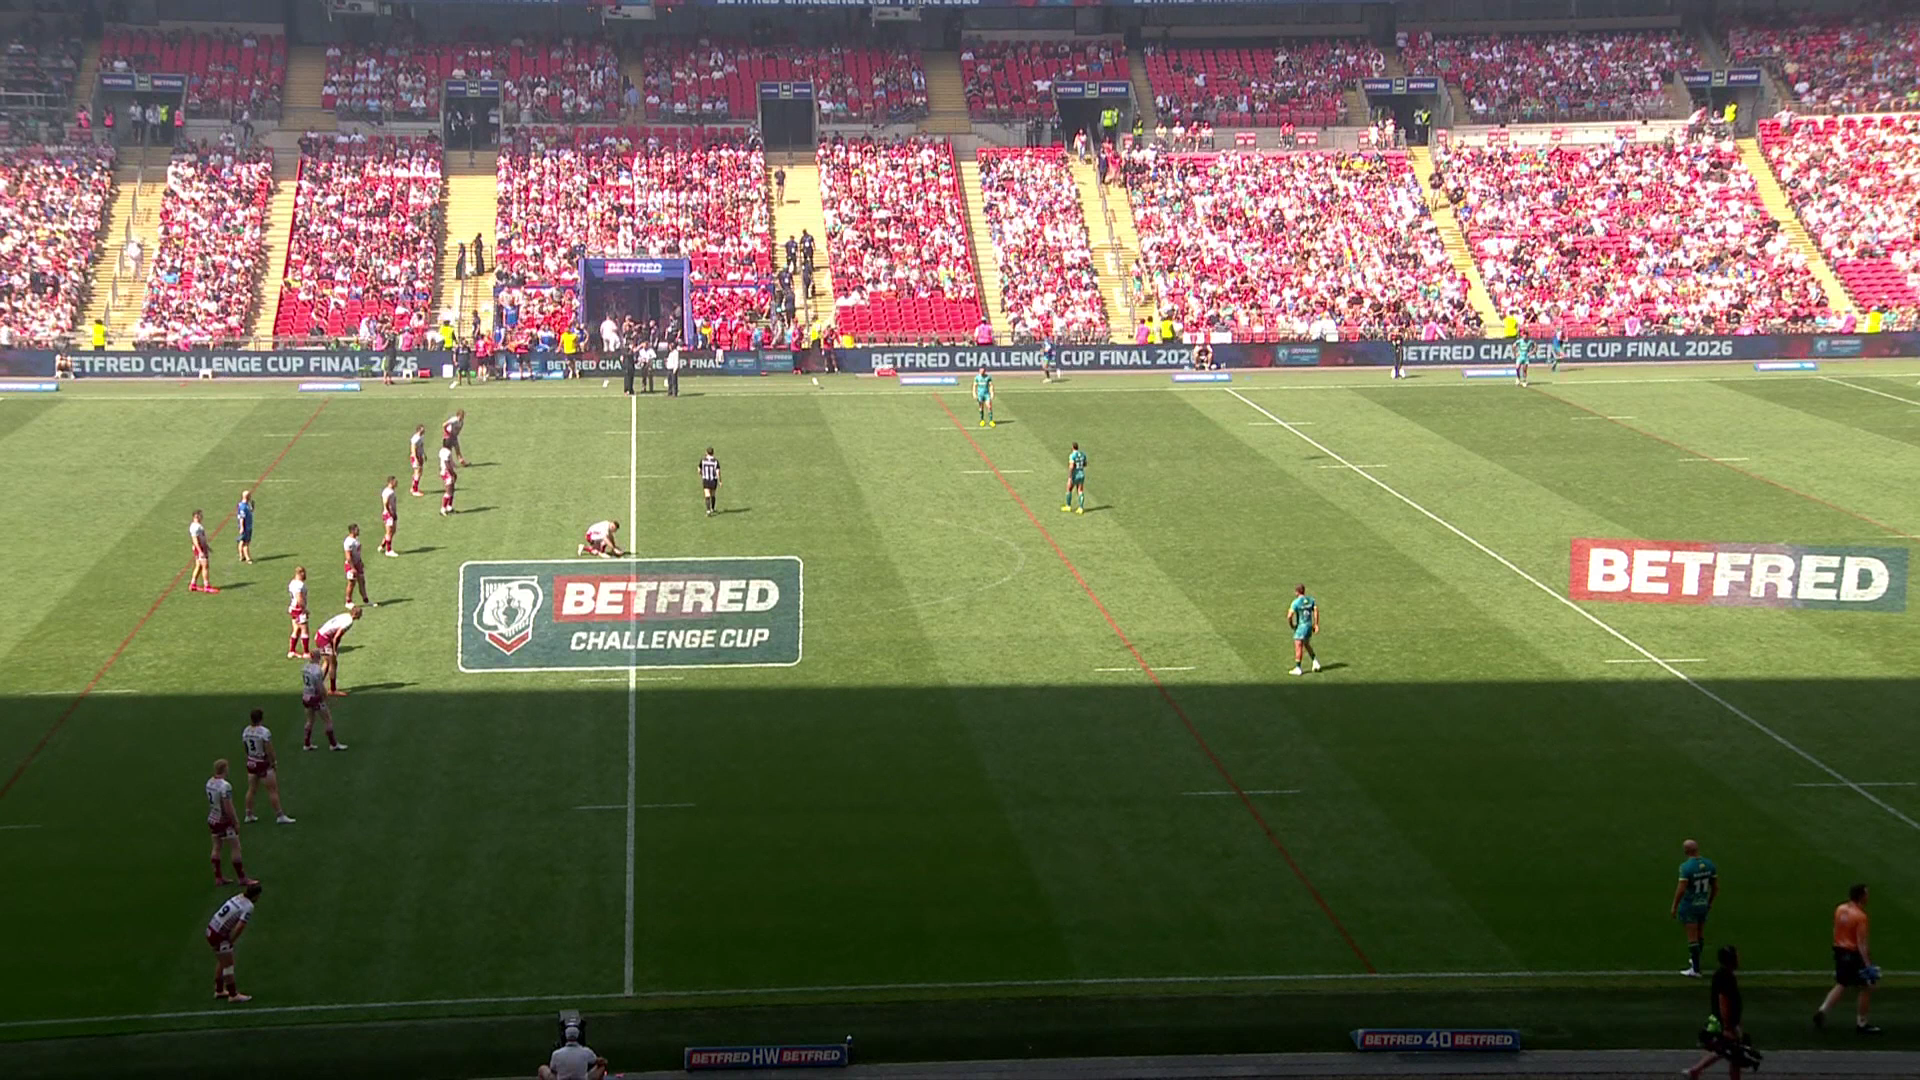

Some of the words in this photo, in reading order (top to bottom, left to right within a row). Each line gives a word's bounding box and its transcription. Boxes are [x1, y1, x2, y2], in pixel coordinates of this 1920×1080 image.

[607, 263, 662, 273] BETFRED
[1586, 342, 1622, 357] CUP
[1627, 341, 1680, 357] FINAL
[1685, 340, 1733, 356] 2026
[72, 356, 145, 372] ETFRED
[150, 356, 262, 372] CHALLENGE
[267, 356, 304, 373] CUP
[310, 356, 363, 372] FINAL
[370, 356, 418, 372] 226
[547, 360, 597, 370] BETRED
[871, 352, 950, 368] BETFRED
[955, 352, 1043, 367] CHALLEN
[1060, 350, 1095, 366] CUP
[1100, 350, 1152, 365] FINAL
[1587, 547, 1889, 602] BETFRED
[562, 580, 779, 615] BETFRED
[570, 630, 716, 651] CHALLENGE
[719, 628, 770, 648] CUP
[1694, 878, 1709, 893] 11
[218, 904, 230, 917] 9
[1364, 1034, 1423, 1046] BETFRED
[1425, 1032, 1452, 1048] 40
[1454, 1034, 1513, 1046] BETFRED
[691, 1052, 751, 1065] BETFRED
[752, 1048, 780, 1065] HW
[782, 1050, 841, 1062] BETFRED
